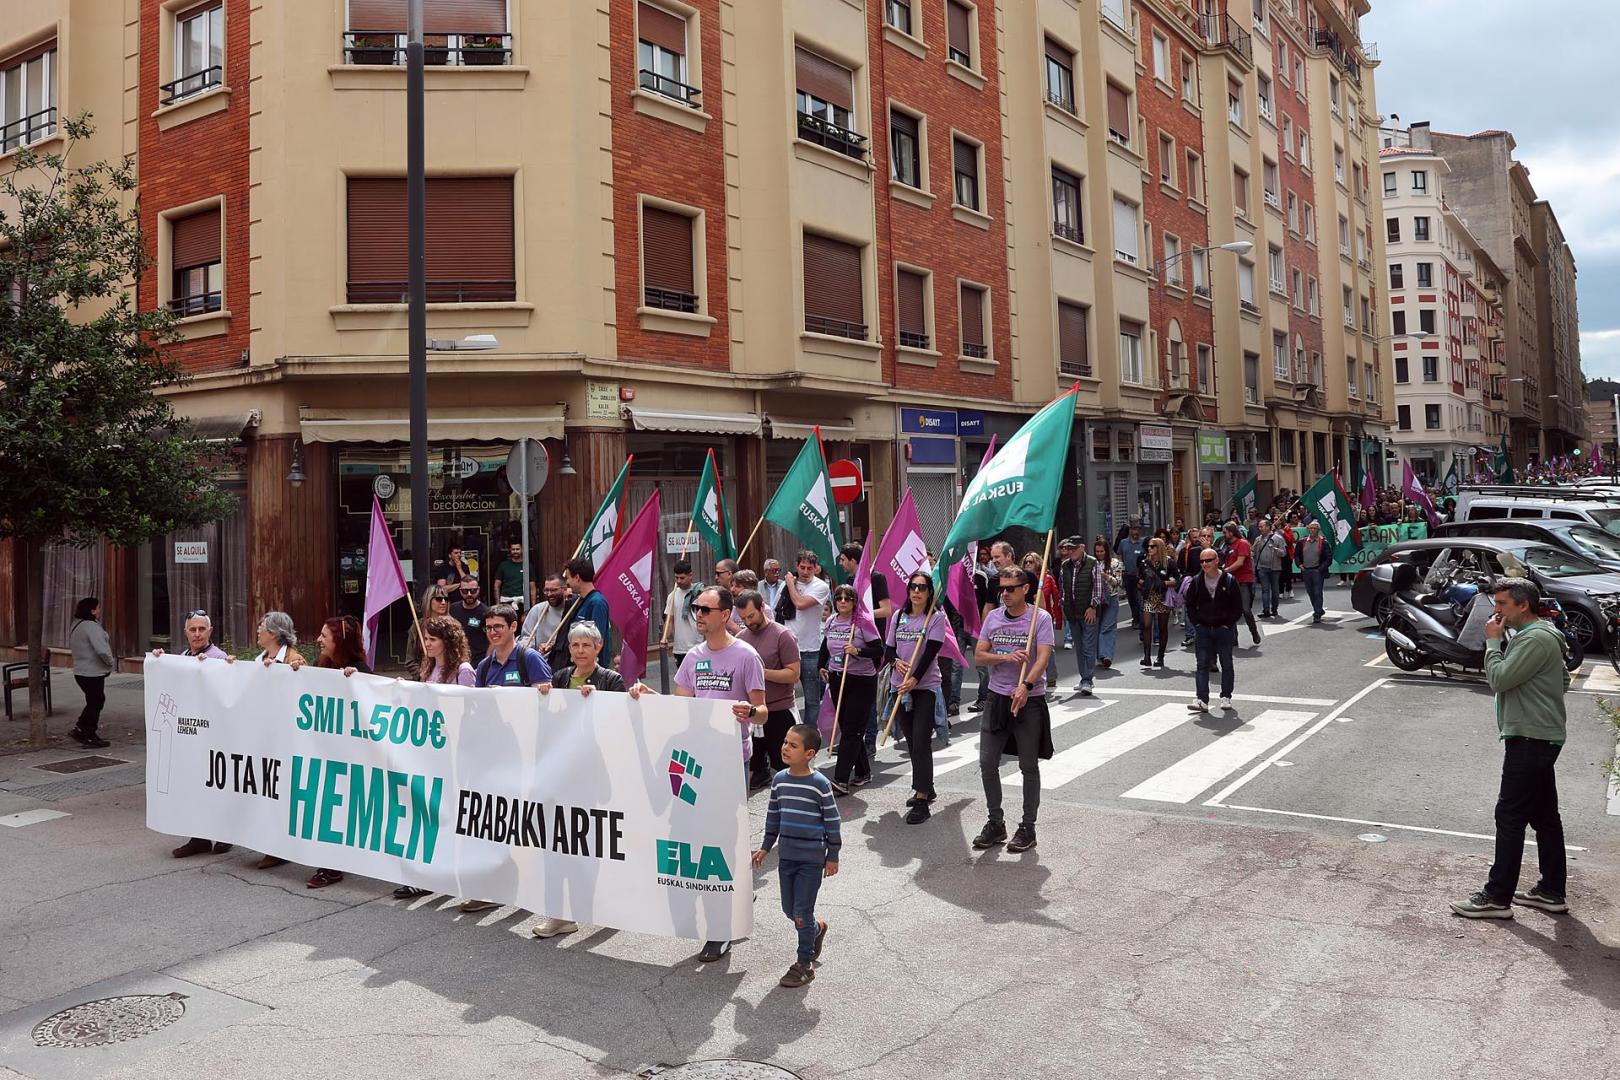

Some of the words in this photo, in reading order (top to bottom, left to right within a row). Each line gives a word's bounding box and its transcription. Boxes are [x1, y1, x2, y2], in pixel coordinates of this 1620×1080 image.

[925, 418, 940, 426] DISAYT
[432, 501, 496, 510] DECORACION
[800, 502, 827, 536] EUSKAL
[176, 546, 182, 556] SE
[184, 546, 206, 556] ALQUILA
[668, 536, 674, 546] SE
[889, 558, 910, 586] EUSKA
[618, 572, 645, 609] EUSKAL
[177, 726, 198, 736] LEHENA
[296, 694, 343, 735] SMI
[350, 700, 446, 750] 1.500€
[206, 750, 226, 790] JO
[231, 754, 257, 794] TA
[262, 757, 281, 800] KE
[288, 756, 443, 864] HEMEN
[456, 789, 546, 849] ERABAKI
[552, 805, 626, 861] ARTE
[656, 839, 734, 882] ELA
[657, 877, 684, 888] EUSKAL
[686, 882, 734, 892] SINDIKATUA
